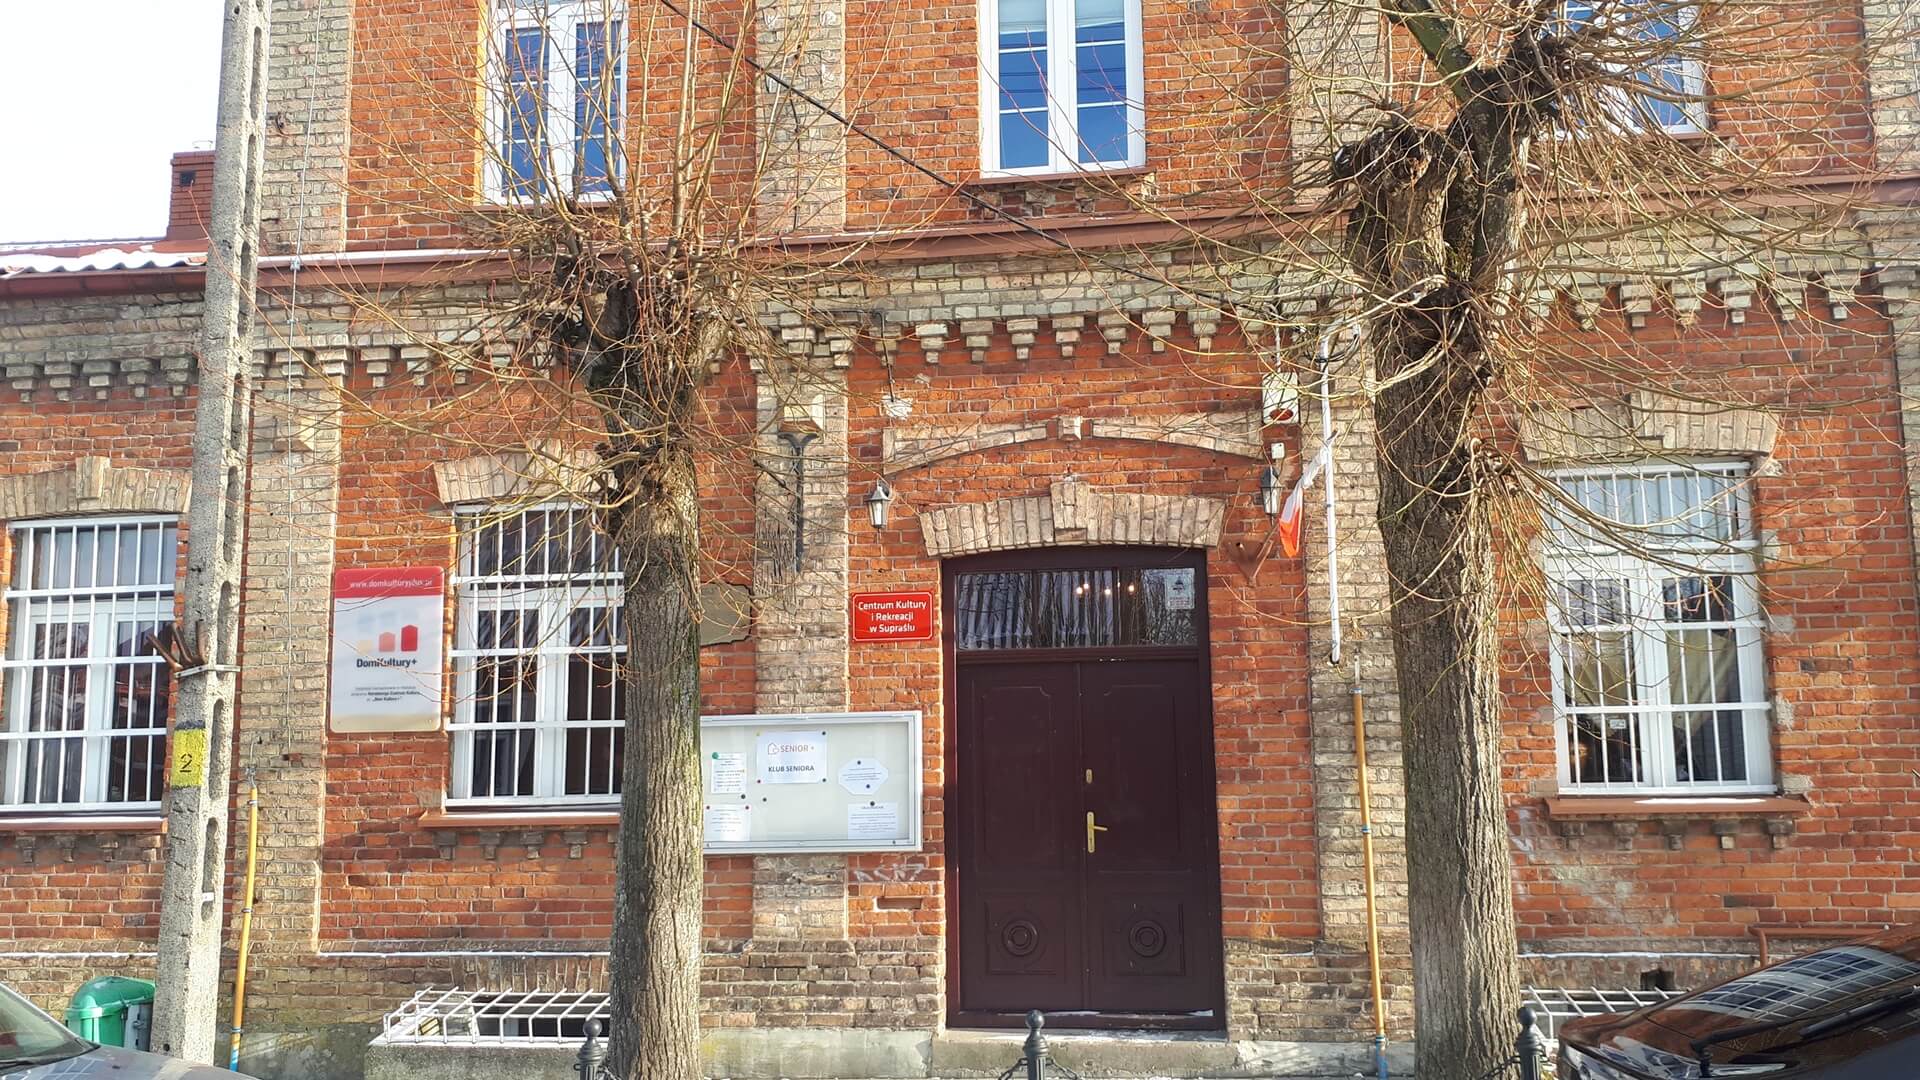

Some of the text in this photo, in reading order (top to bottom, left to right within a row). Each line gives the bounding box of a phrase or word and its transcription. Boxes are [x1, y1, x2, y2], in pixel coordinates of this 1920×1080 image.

[858, 600, 926, 610] Centrum Kultury
[871, 612, 913, 621] i Rekreacji
[879, 623, 915, 634] Supraślu
[780, 744, 809, 753] SENIOR
[180, 753, 193, 773] 2
[768, 765, 785, 773] KLUB
